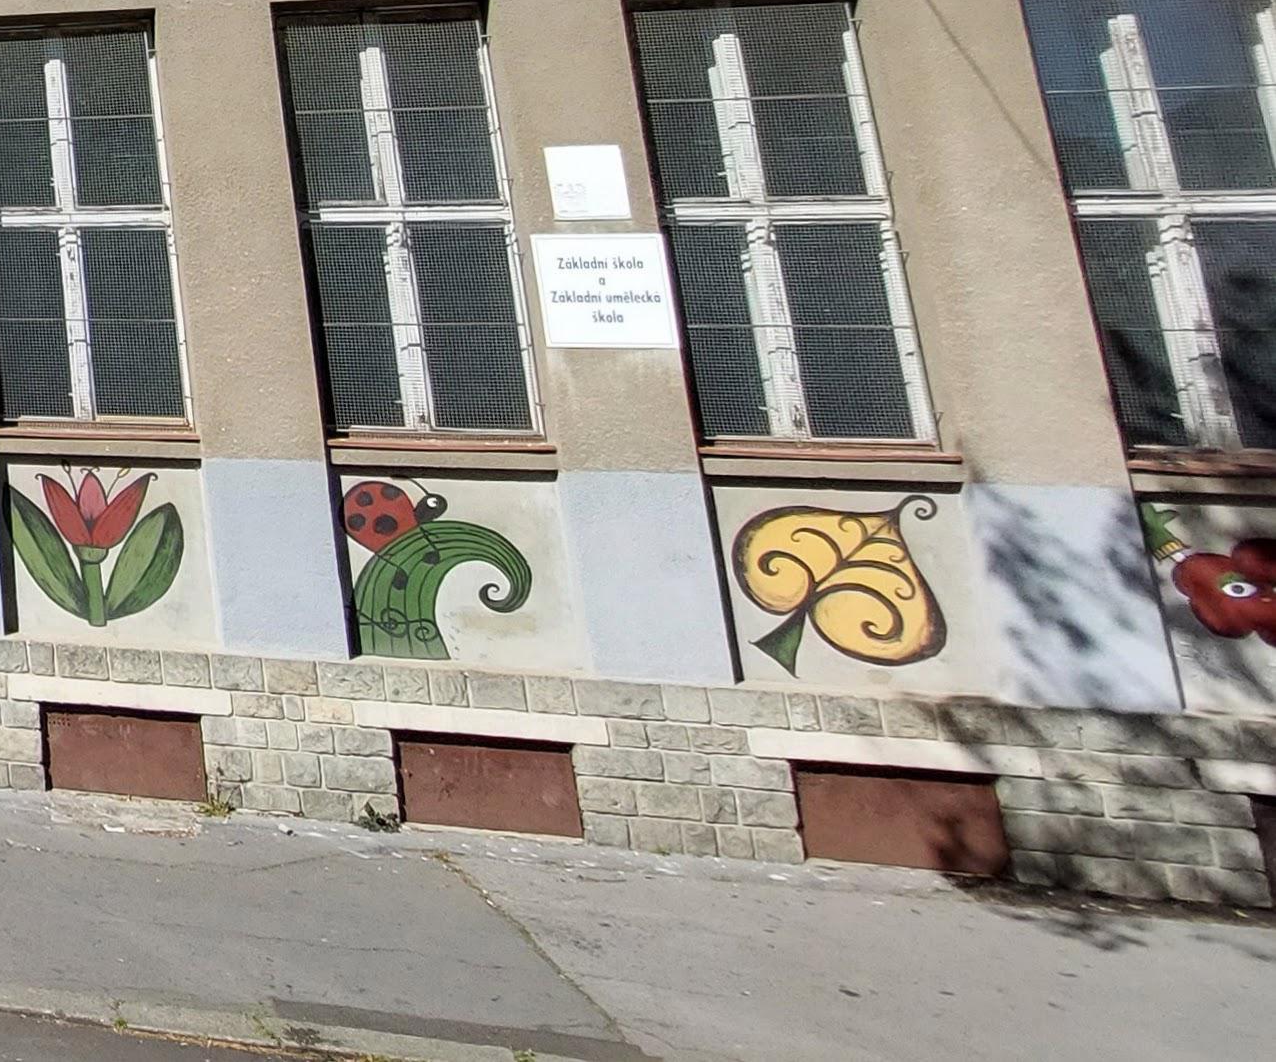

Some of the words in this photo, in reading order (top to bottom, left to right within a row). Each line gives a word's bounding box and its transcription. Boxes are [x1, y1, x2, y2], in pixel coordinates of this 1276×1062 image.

[557, 256, 608, 270] Základní
[612, 256, 644, 270] škola
[598, 277, 606, 286] a
[550, 290, 602, 304] Základní
[605, 290, 661, 304] umělecká
[592, 310, 624, 324] škola
